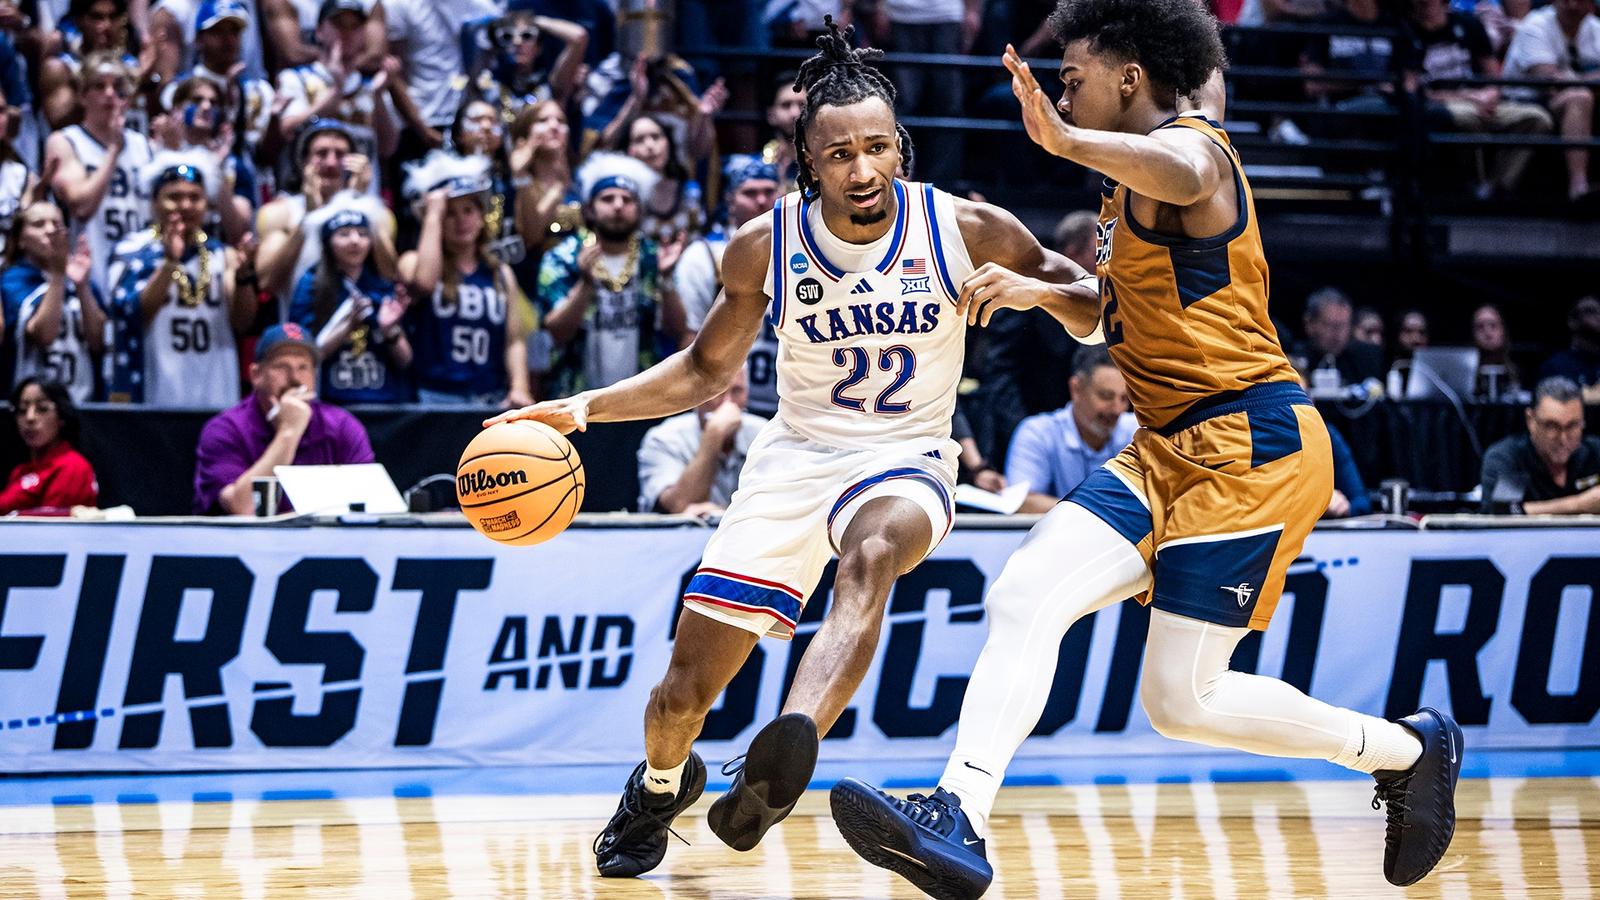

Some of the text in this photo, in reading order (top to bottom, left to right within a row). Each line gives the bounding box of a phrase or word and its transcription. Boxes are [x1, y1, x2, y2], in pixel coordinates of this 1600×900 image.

[792, 262, 808, 270] NCAA
[432, 280, 507, 326] CBU
[798, 284, 820, 300] SW
[171, 317, 210, 354] 50
[796, 301, 941, 343] KANSAS
[452, 326, 490, 365] 50
[830, 344, 917, 414] 22
[459, 468, 528, 497] Wilson
[0, 553, 496, 750] FIRST
[483, 615, 635, 690] AND
